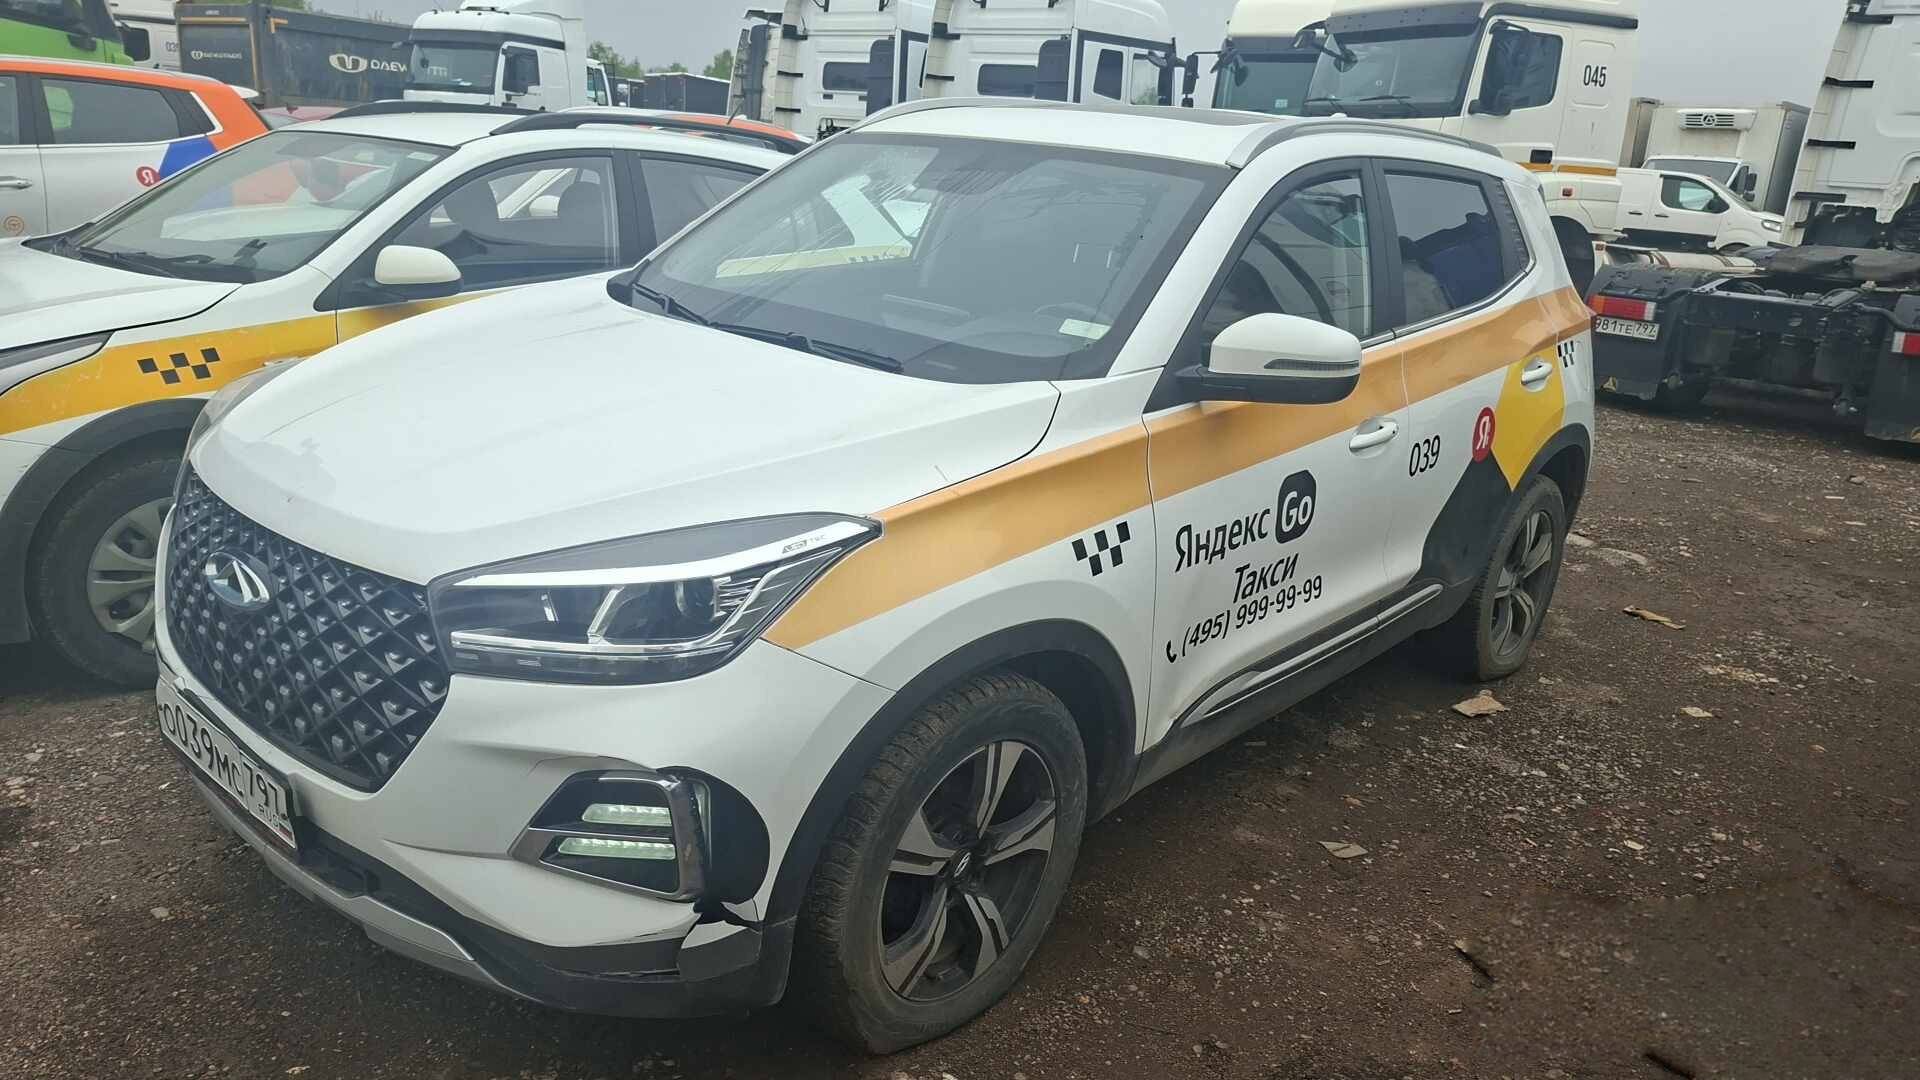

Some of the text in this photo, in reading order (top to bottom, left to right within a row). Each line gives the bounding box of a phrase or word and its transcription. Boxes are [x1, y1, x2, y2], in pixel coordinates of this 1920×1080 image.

[1583, 64, 1607, 87] 045
[1409, 434, 1440, 477] 039
[1476, 415, 1491, 450] Я
[1175, 491, 1313, 573] Яндекс Go
[1233, 553, 1299, 604] Такси
[1182, 575, 1322, 657] (495) 999-99-99
